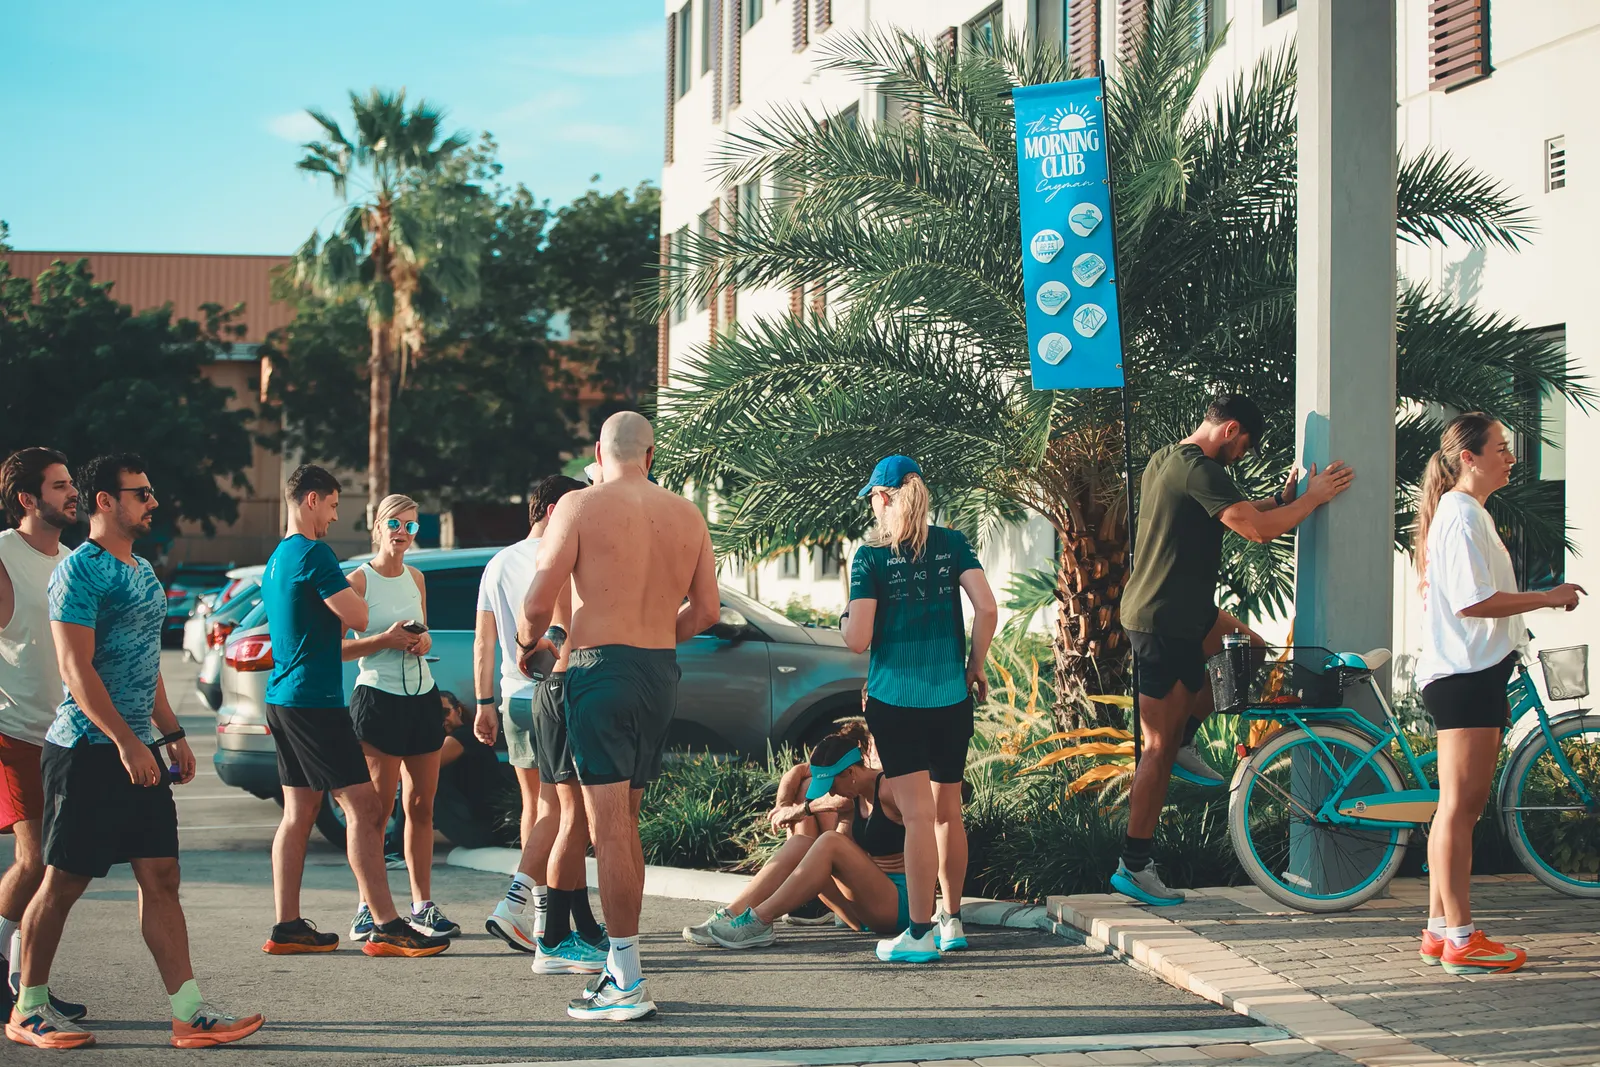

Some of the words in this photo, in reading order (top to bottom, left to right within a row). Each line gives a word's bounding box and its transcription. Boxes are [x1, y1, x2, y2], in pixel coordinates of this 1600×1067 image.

[1025, 115, 1049, 136] The
[1024, 129, 1099, 159] MORNING
[1041, 153, 1086, 179] CLUB
[1035, 178, 1094, 203] Cayman
[887, 556, 906, 566] HOKA
